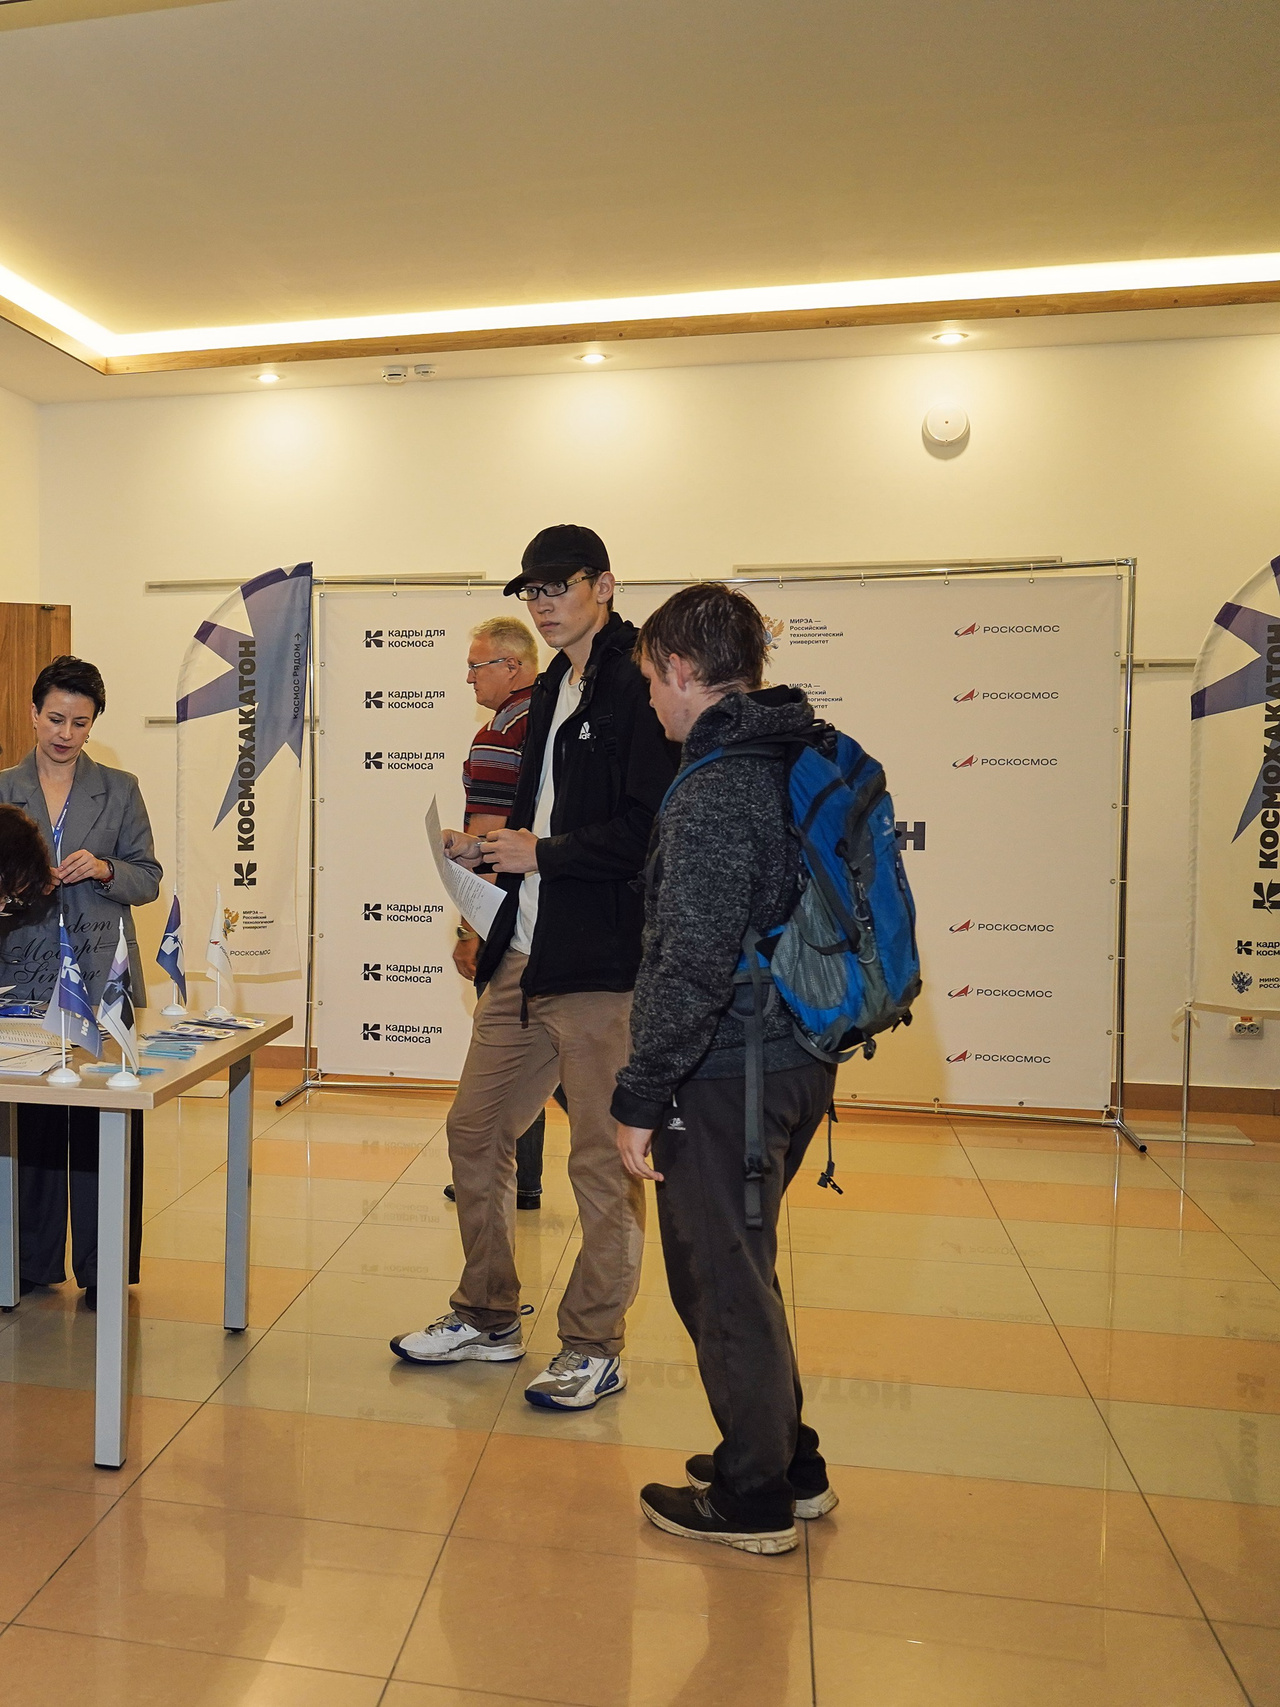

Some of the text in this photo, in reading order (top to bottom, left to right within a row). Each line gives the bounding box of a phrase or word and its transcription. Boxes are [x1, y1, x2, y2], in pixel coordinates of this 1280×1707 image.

[388, 629, 445, 638] кадры для
[984, 625, 1059, 633] РОСКОСМОС
[292, 643, 301, 677] РЯДОМ
[388, 691, 445, 700] кадры для
[388, 701, 434, 709] космоса
[237, 640, 256, 852] КОСМОХАКАТОН
[388, 752, 445, 761] кадры для
[388, 762, 433, 770] космоса
[386, 903, 444, 913] кадры для
[386, 914, 432, 923] космоса
[978, 924, 1054, 932] РОСКОСМОС
[386, 964, 443, 973] кадры для
[386, 974, 432, 983] космоса
[977, 989, 1052, 998] РОСКОСМОС
[386, 1024, 442, 1034] кадры для
[385, 1034, 431, 1043] космоса
[975, 1054, 1050, 1063] РОСКОСМОС
